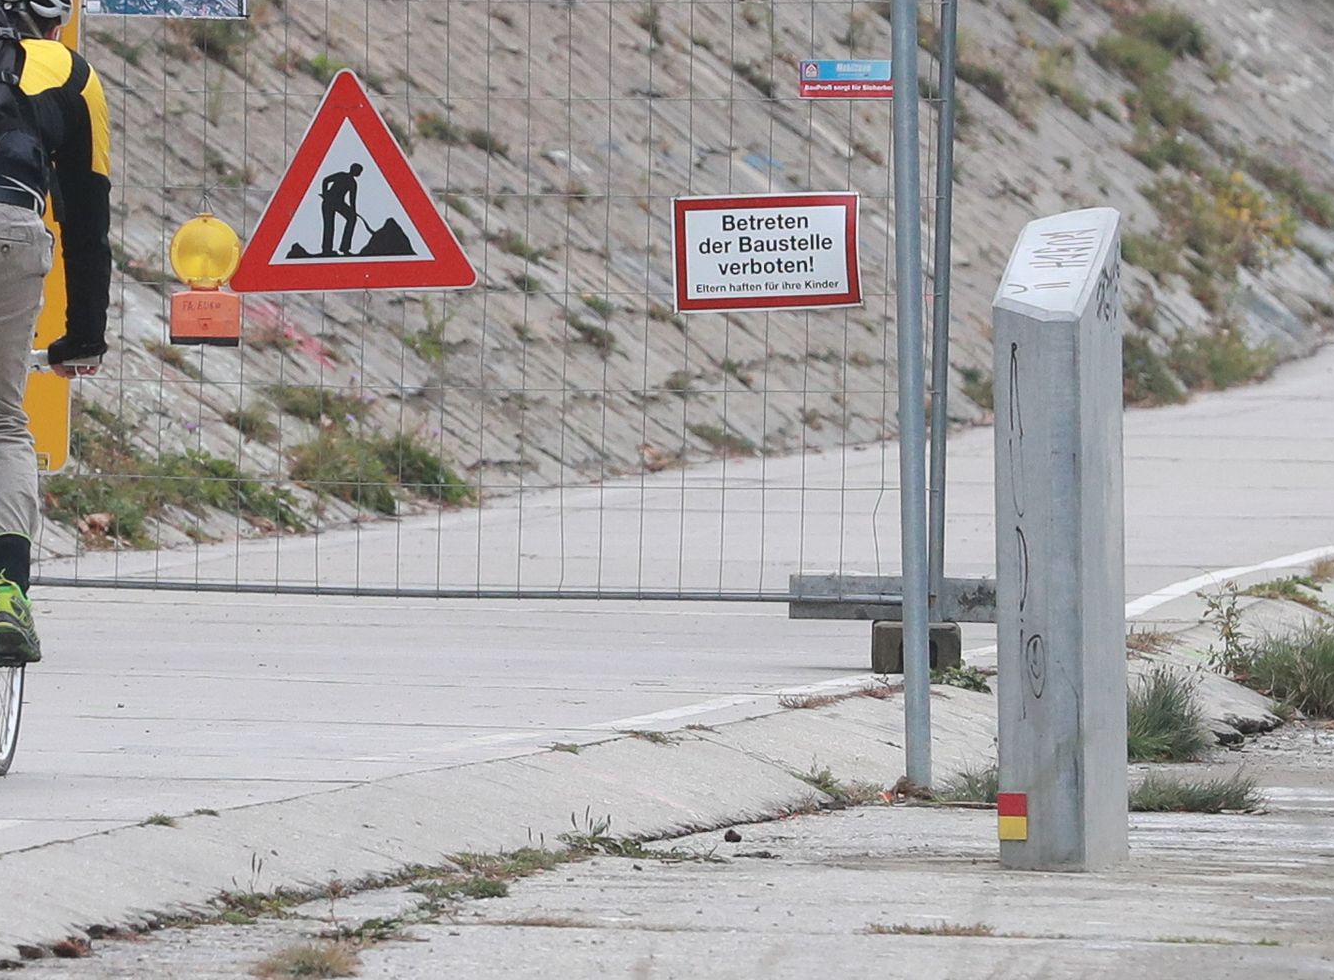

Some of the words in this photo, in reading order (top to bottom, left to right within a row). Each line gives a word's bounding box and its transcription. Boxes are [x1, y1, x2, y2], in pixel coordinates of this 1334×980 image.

[722, 214, 809, 232] Betreten
[698, 238, 732, 254] der
[738, 233, 833, 253] Baustelle
[718, 256, 815, 276] verboten!
[696, 284, 727, 293] Eltern
[729, 281, 762, 293] haften
[764, 281, 780, 291] für
[781, 280, 802, 290] ihre
[804, 279, 839, 289] Kinder
